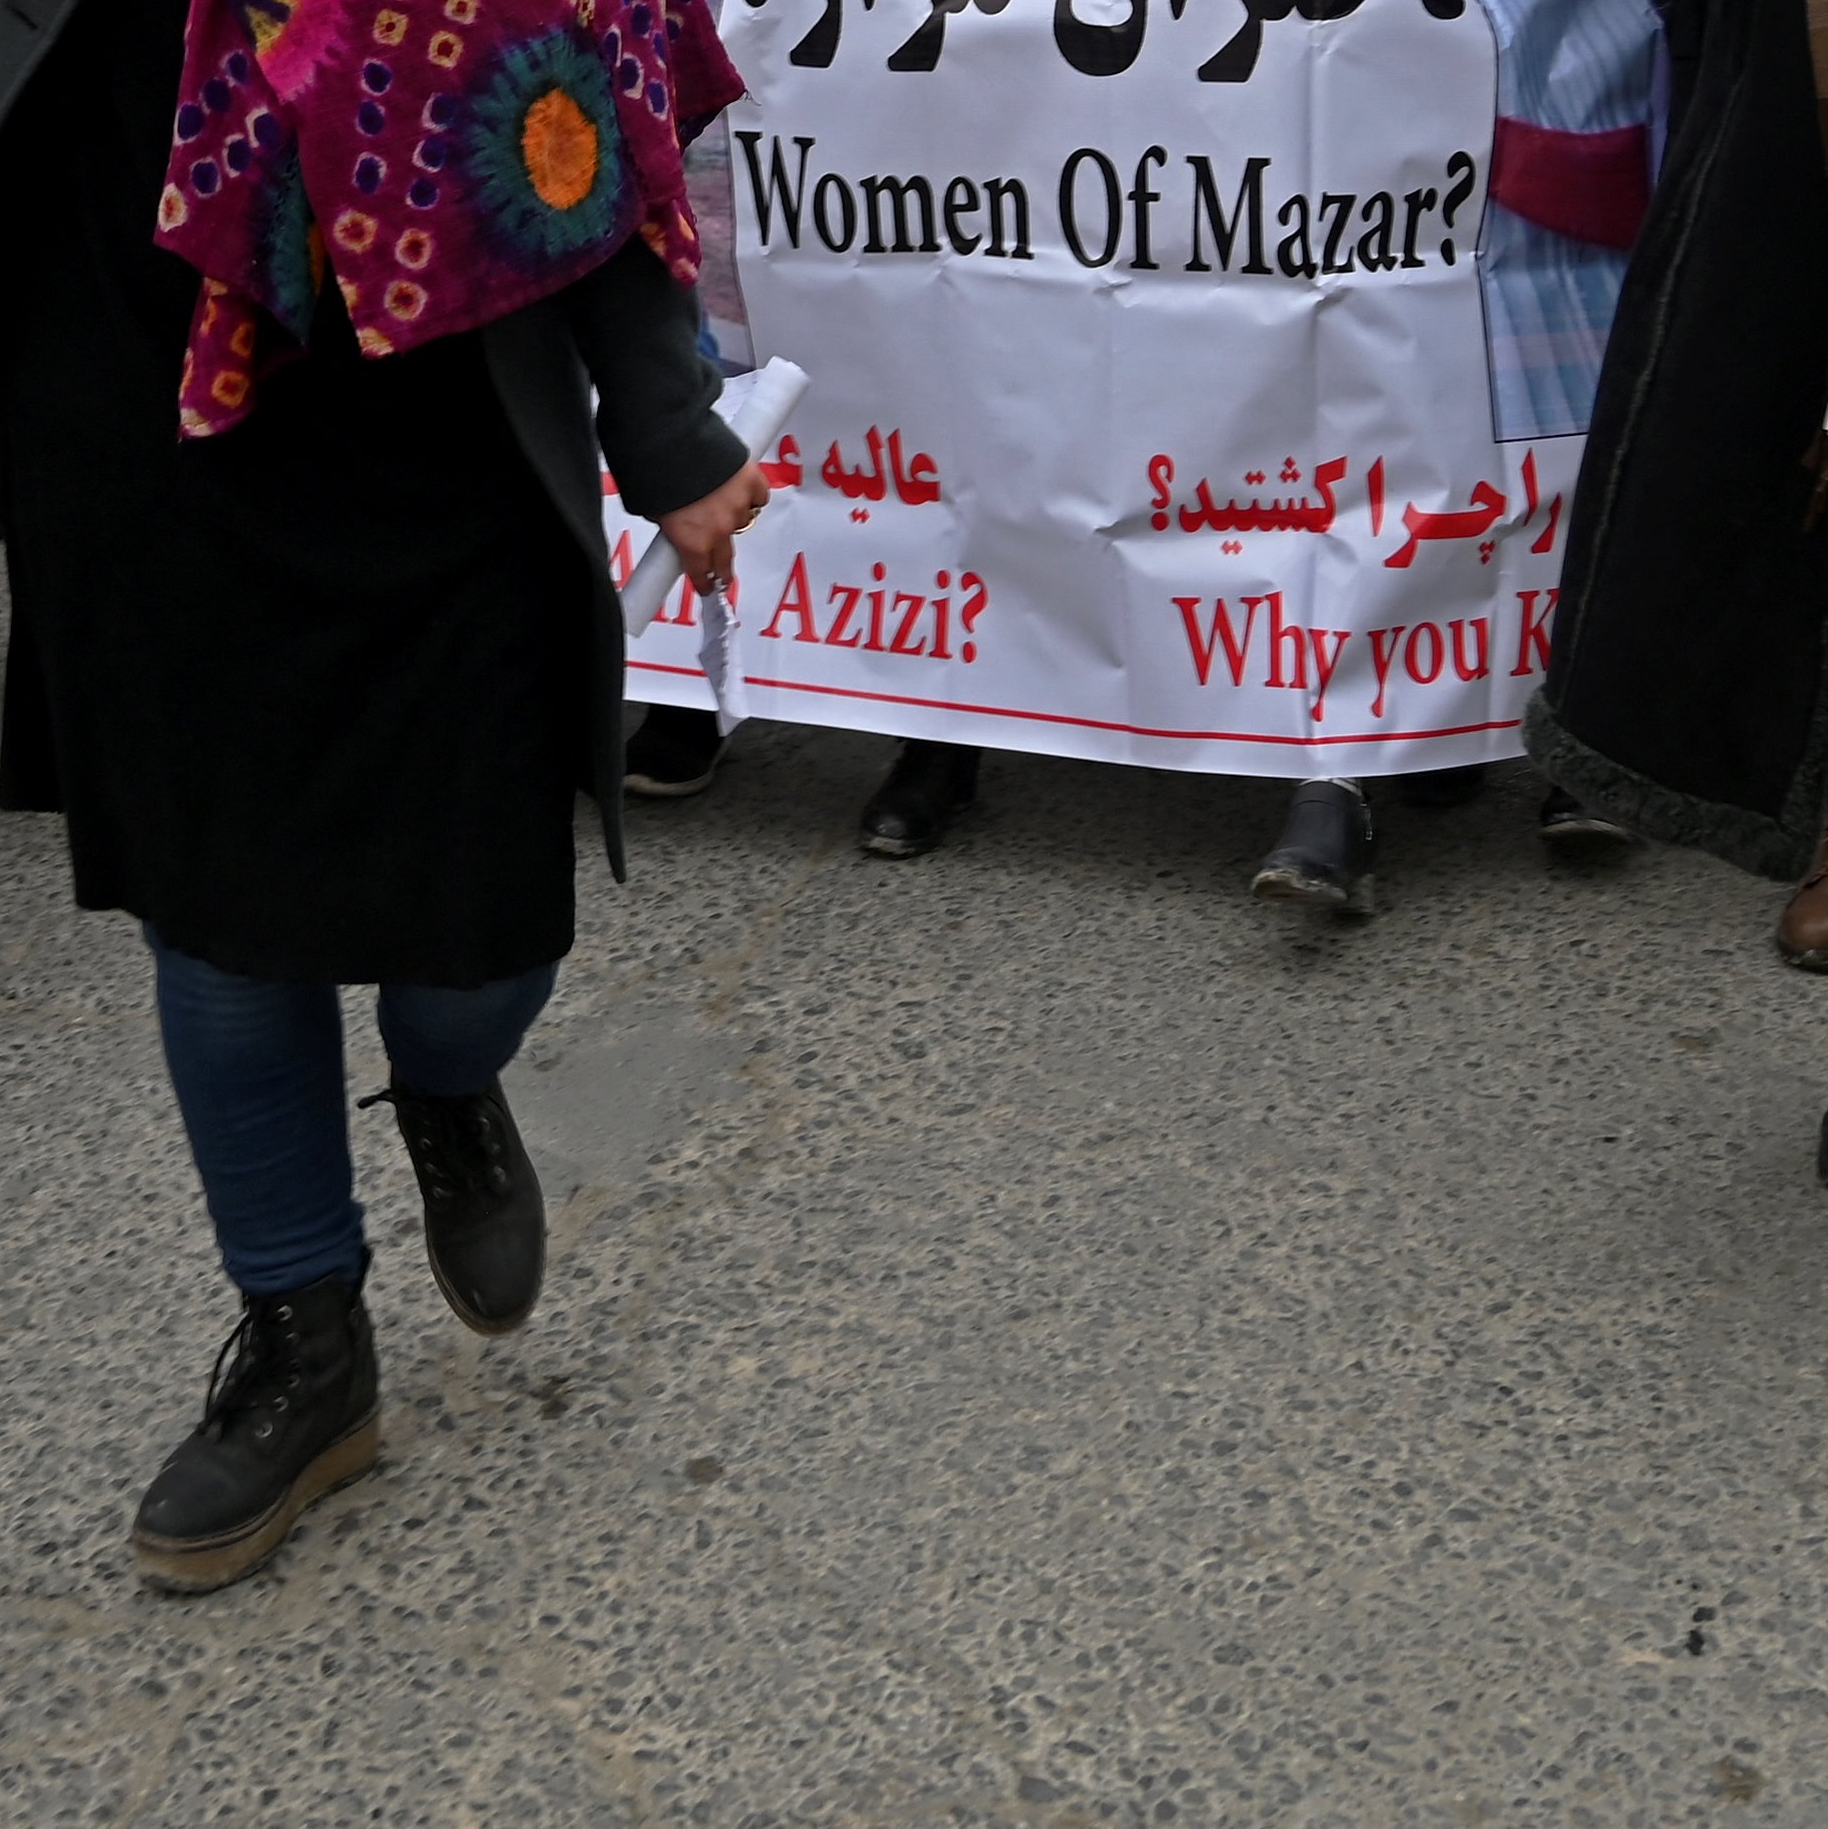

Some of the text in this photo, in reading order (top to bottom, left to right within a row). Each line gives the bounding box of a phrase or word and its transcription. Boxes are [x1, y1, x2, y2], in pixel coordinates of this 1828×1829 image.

[734, 130, 1477, 280] Women Of Mazar?
[759, 551, 989, 664] Azizi?
[1171, 589, 1353, 722] Why
[1367, 616, 1490, 718] you
